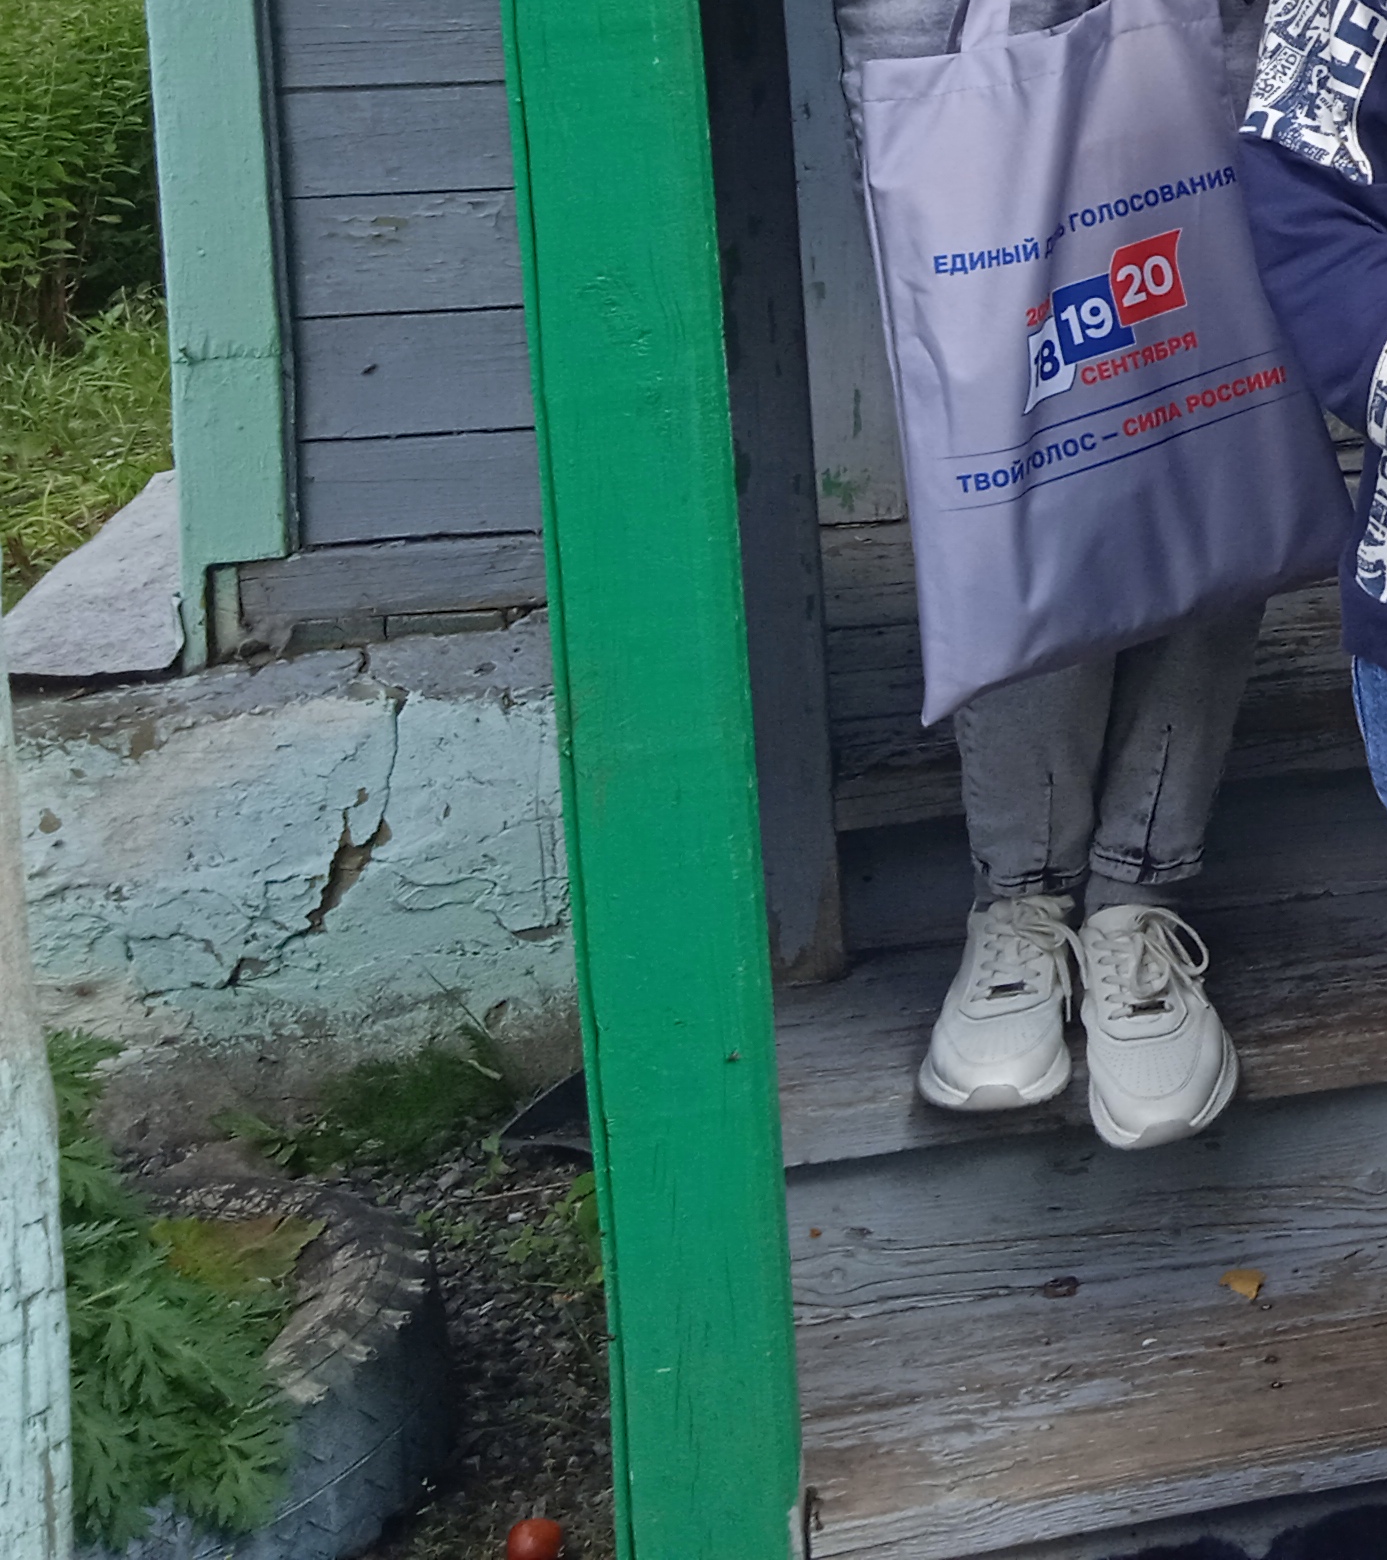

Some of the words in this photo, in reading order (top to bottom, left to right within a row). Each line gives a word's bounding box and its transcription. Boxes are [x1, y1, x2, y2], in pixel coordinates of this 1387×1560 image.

[933, 237, 1041, 275] ЕДИНЫЙ
[1067, 165, 1237, 232] ГОЛОСОВАНИЯ
[1060, 297, 1114, 346] 19
[1116, 255, 1174, 308] 20
[1080, 330, 1199, 386] СЕНТЯБРЯ
[956, 458, 1025, 494] ТВОЙ
[1122, 400, 1183, 438] СИЛА
[1186, 365, 1288, 414] РОССИИ!
